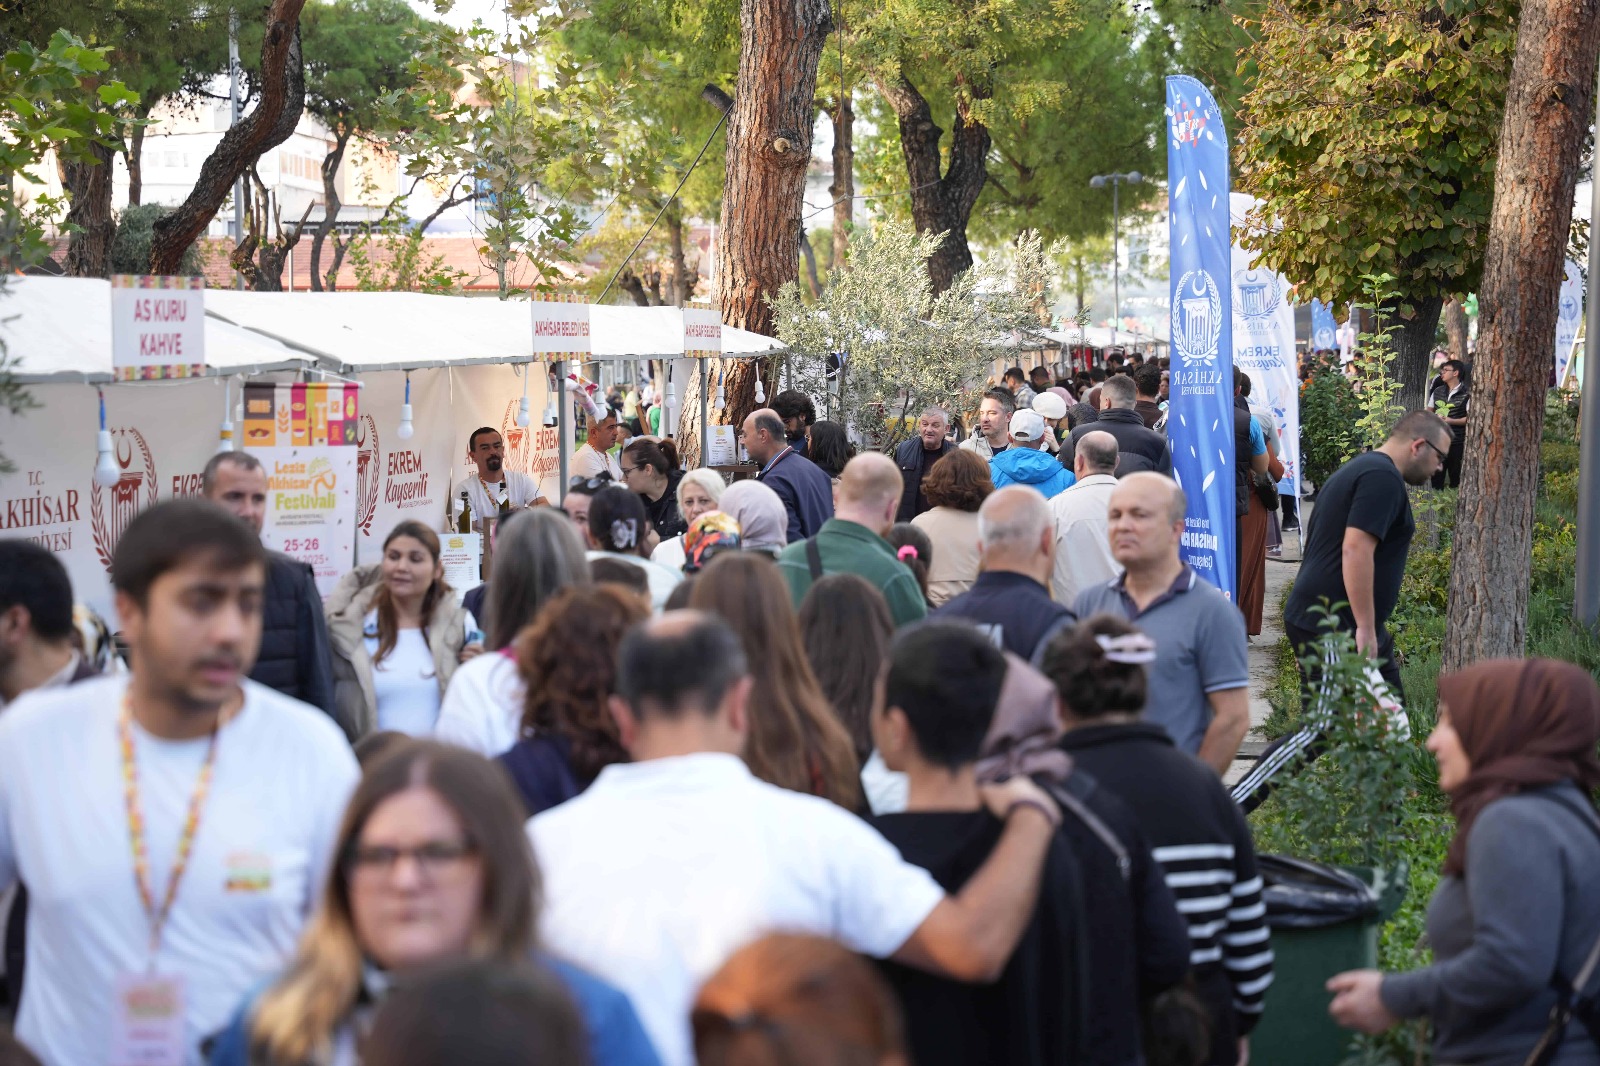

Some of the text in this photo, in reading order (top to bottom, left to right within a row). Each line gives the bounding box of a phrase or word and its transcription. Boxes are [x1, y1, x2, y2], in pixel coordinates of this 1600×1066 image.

[134, 298, 187, 322] AS KURU
[534, 318, 561, 337] AKHİSAR
[140, 333, 182, 355] KAHVE
[387, 449, 422, 476] EKREM
[28, 471, 45, 486] T.C.
[172, 472, 205, 501] EKRE
[275, 491, 336, 511] Festivali
[384, 472, 429, 510] Kayserili
[284, 538, 320, 552] 25-26
